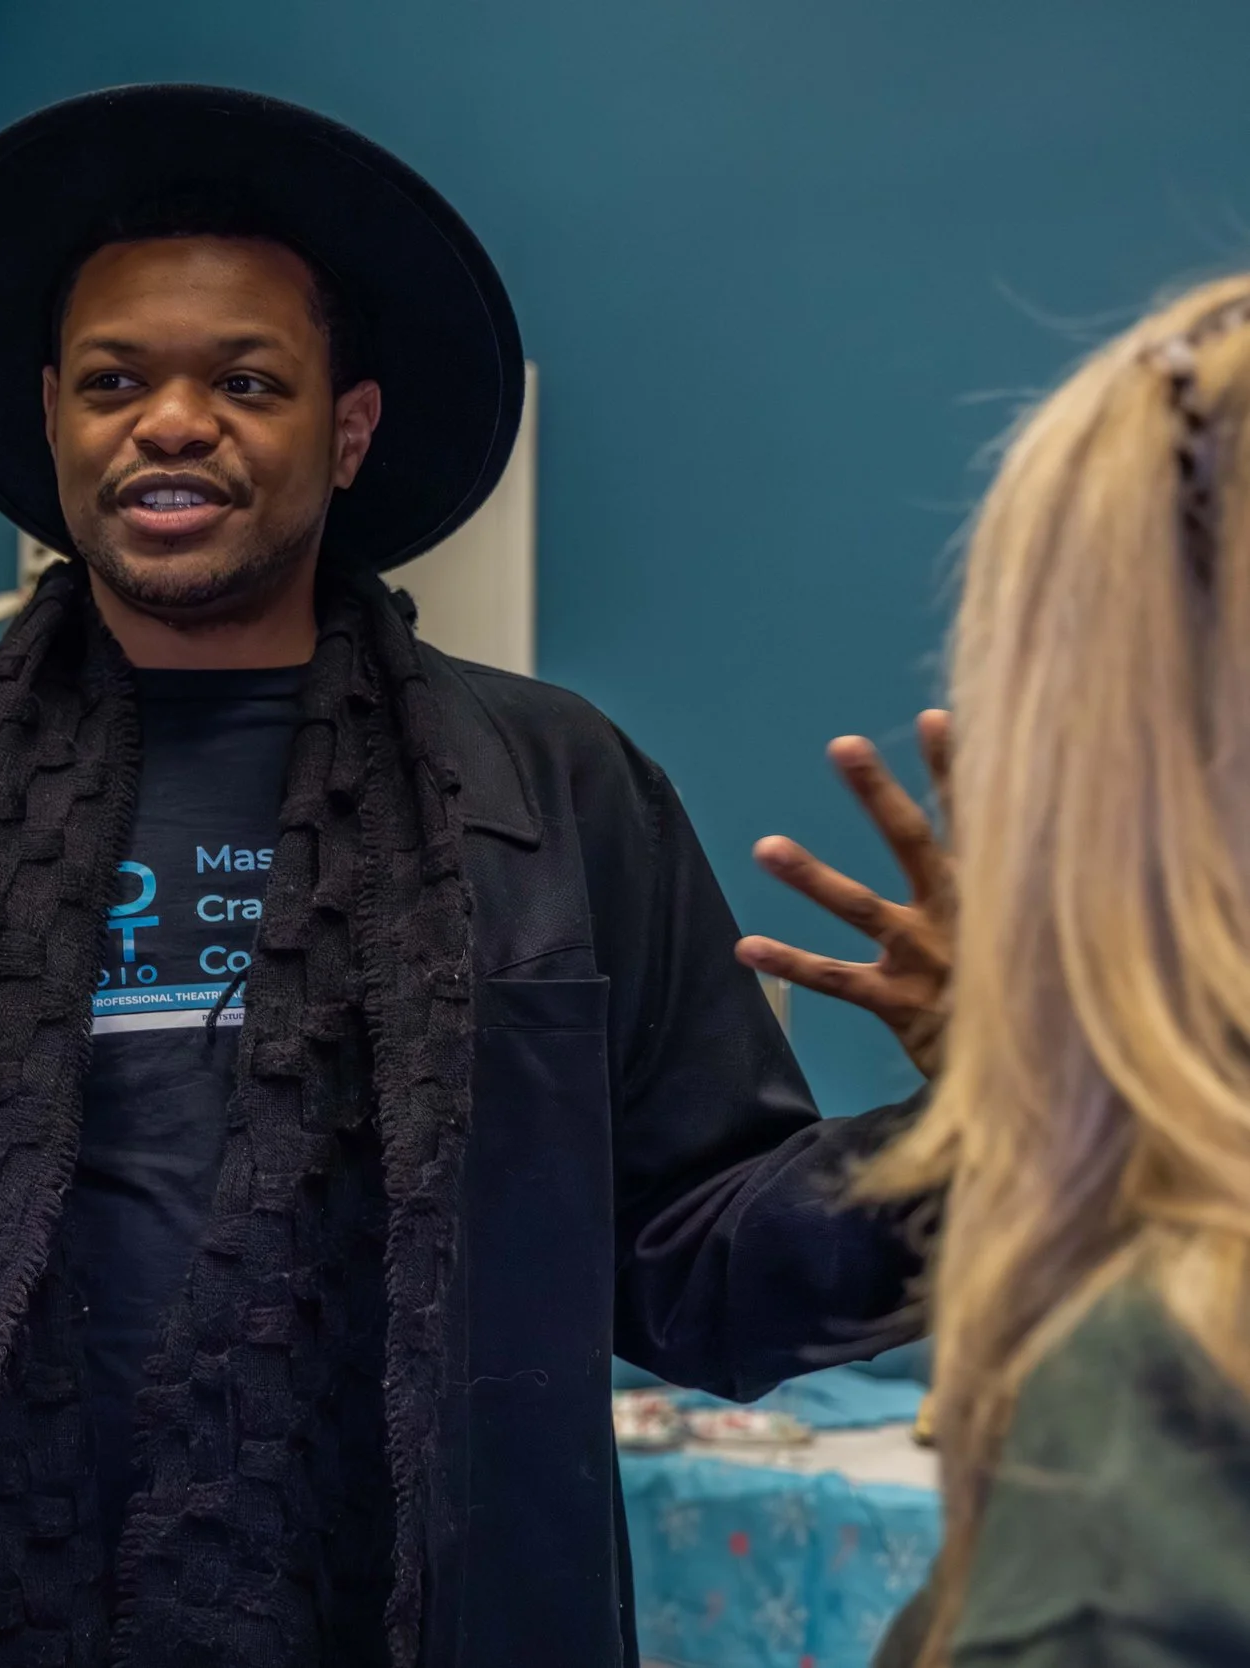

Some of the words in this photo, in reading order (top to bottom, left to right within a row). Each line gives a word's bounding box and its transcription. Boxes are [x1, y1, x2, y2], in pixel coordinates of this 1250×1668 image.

[196, 844, 274, 873] Mas
[197, 894, 263, 922] Cra
[199, 945, 252, 975] Co
[175, 989, 243, 1001] THEATRIAL
